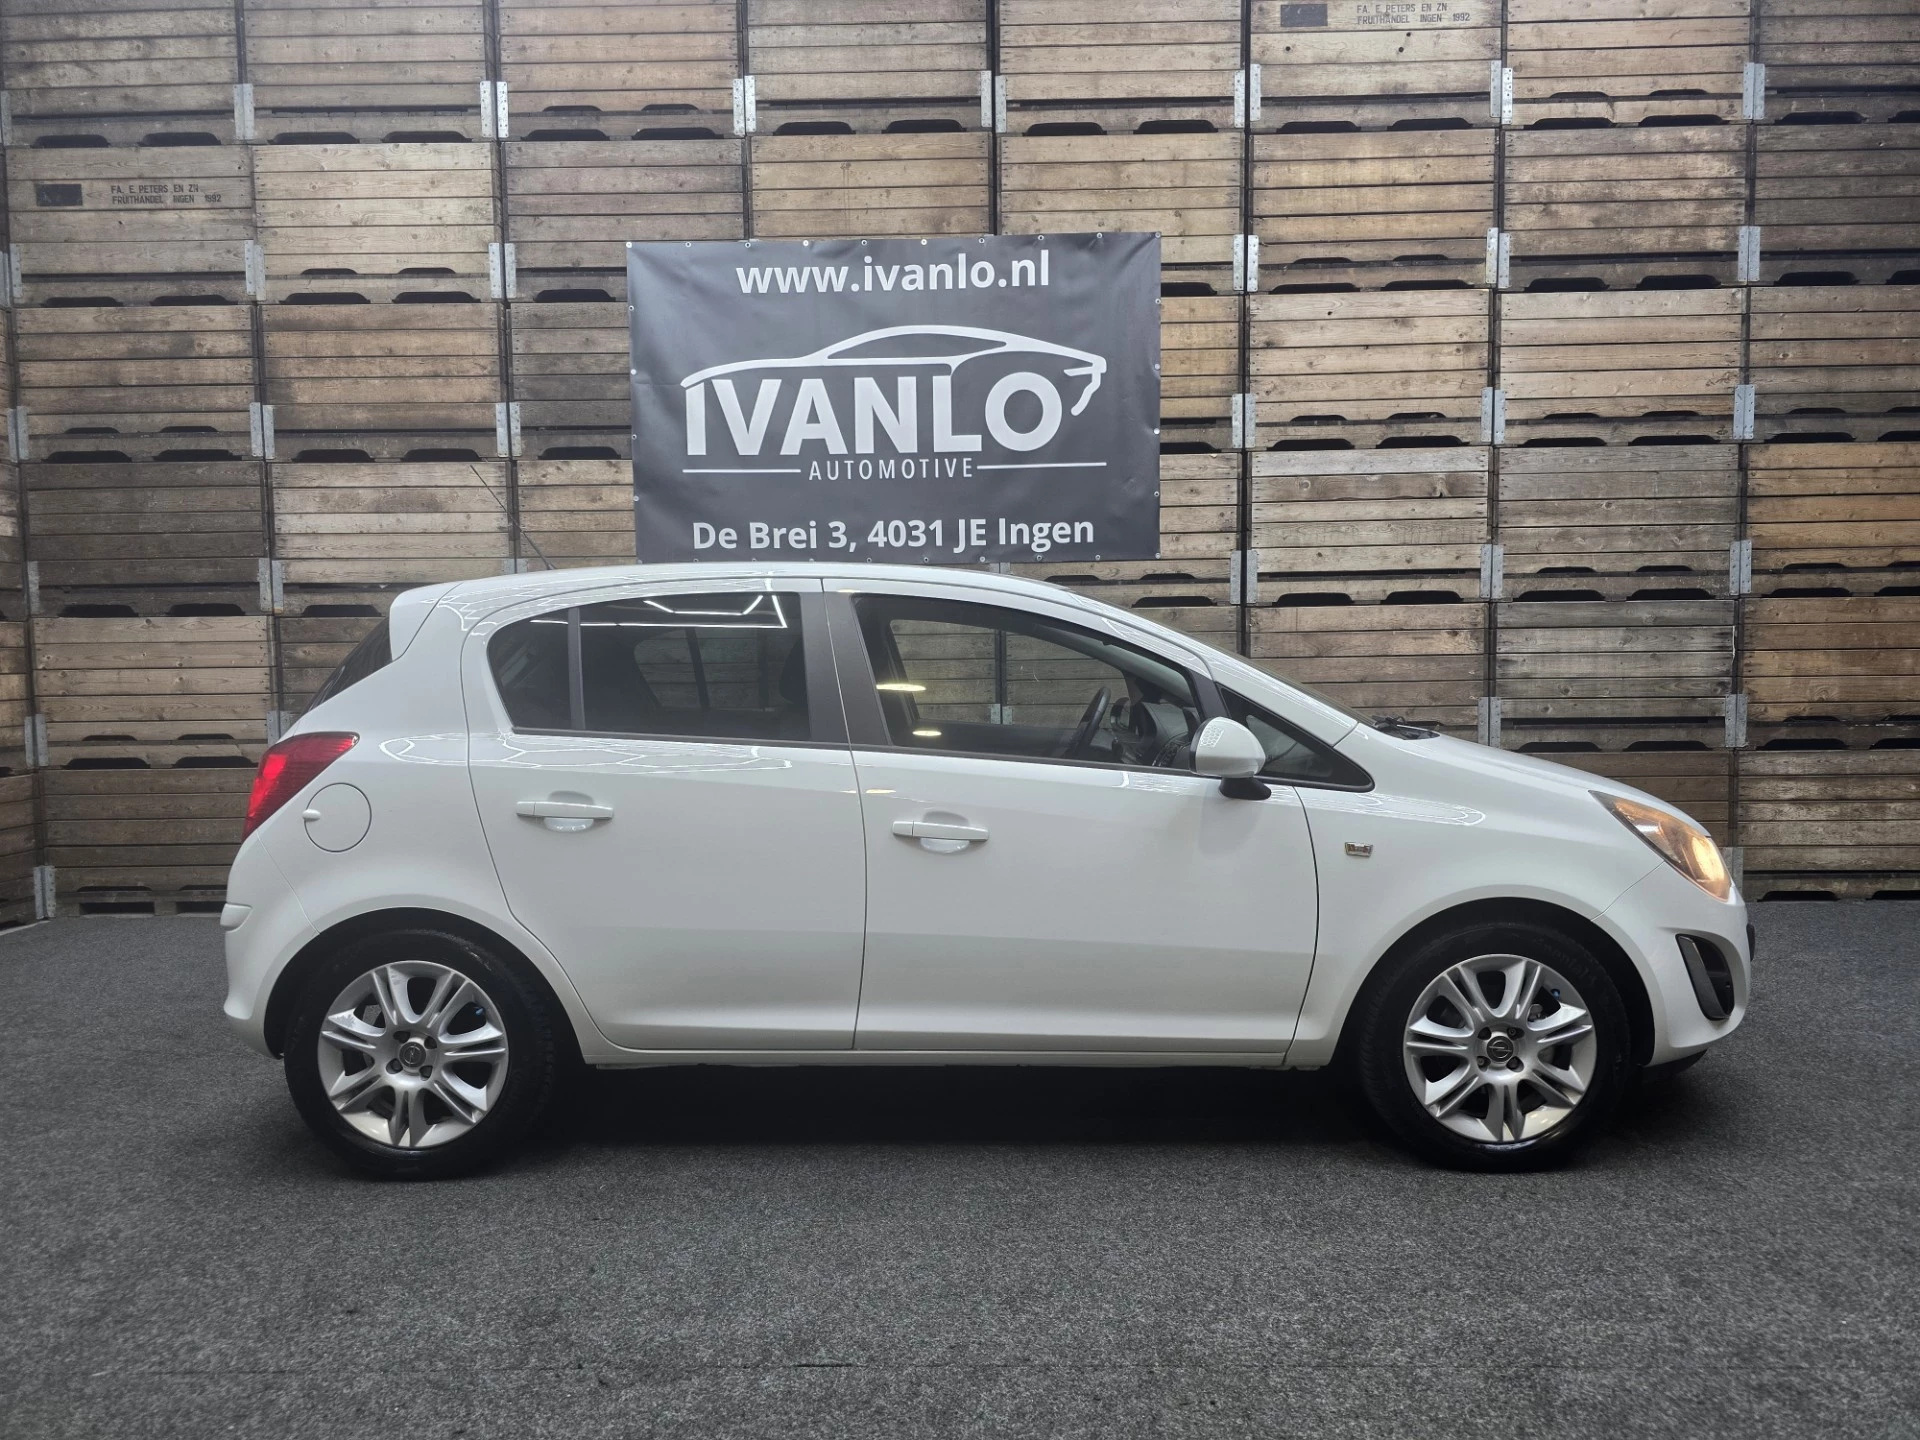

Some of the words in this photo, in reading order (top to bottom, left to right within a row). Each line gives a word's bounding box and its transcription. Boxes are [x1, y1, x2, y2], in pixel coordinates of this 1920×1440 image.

[1385, 3, 1416, 13] PETERS
[1421, 3, 1432, 12] EN
[1436, 2, 1448, 12] ZN
[1357, 14, 1410, 25] FRUITHANDEL
[1419, 13, 1443, 23] INGEN
[138, 184, 169, 194] PETERS
[173, 184, 184, 193] EN
[188, 183, 199, 193] ZN
[112, 195, 164, 205] FRUITHANDEL
[172, 194, 195, 204] INGEN
[736, 249, 1050, 294] www.ivanlo.nl
[685, 371, 1063, 456] IVANLO
[808, 457, 973, 481] AUTOMOTIVE
[693, 521, 738, 550] De
[749, 520, 818, 549] Brei
[828, 520, 857, 553] 3,
[867, 519, 943, 548] 4031
[953, 518, 987, 554] JE
[998, 517, 1094, 553] Ingen
